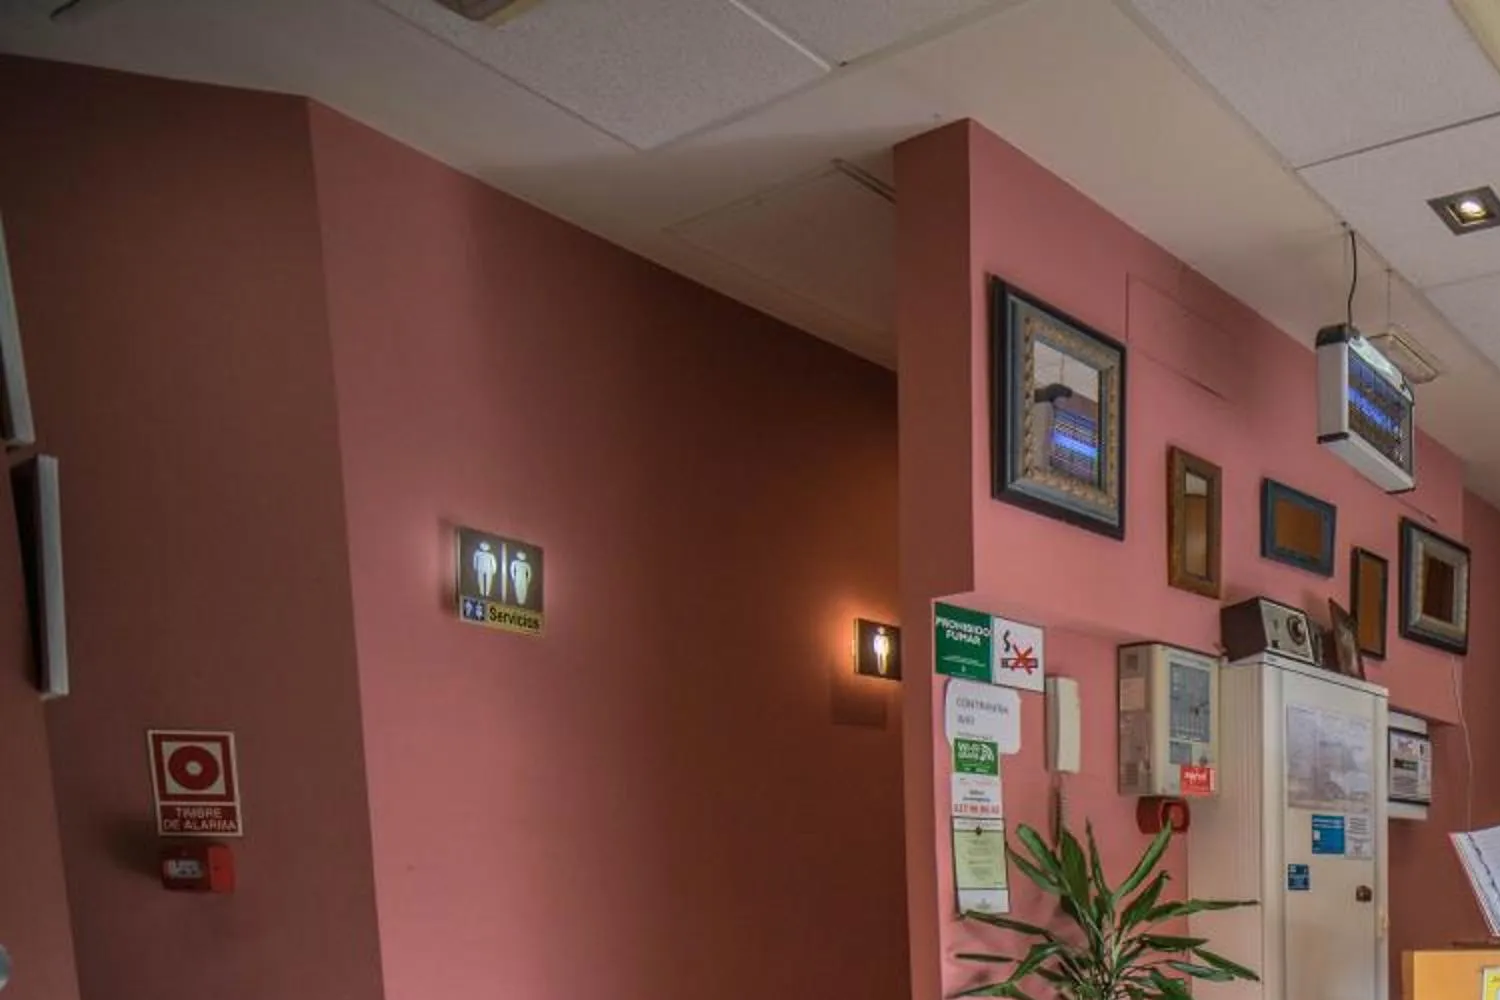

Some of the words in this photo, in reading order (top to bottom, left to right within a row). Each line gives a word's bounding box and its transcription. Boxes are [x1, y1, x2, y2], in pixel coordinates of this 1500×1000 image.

[489, 606, 539, 629] Servicios
[175, 807, 223, 819] TIMBRE
[163, 819, 182, 831] DE
[184, 819, 238, 831] ALARMA
